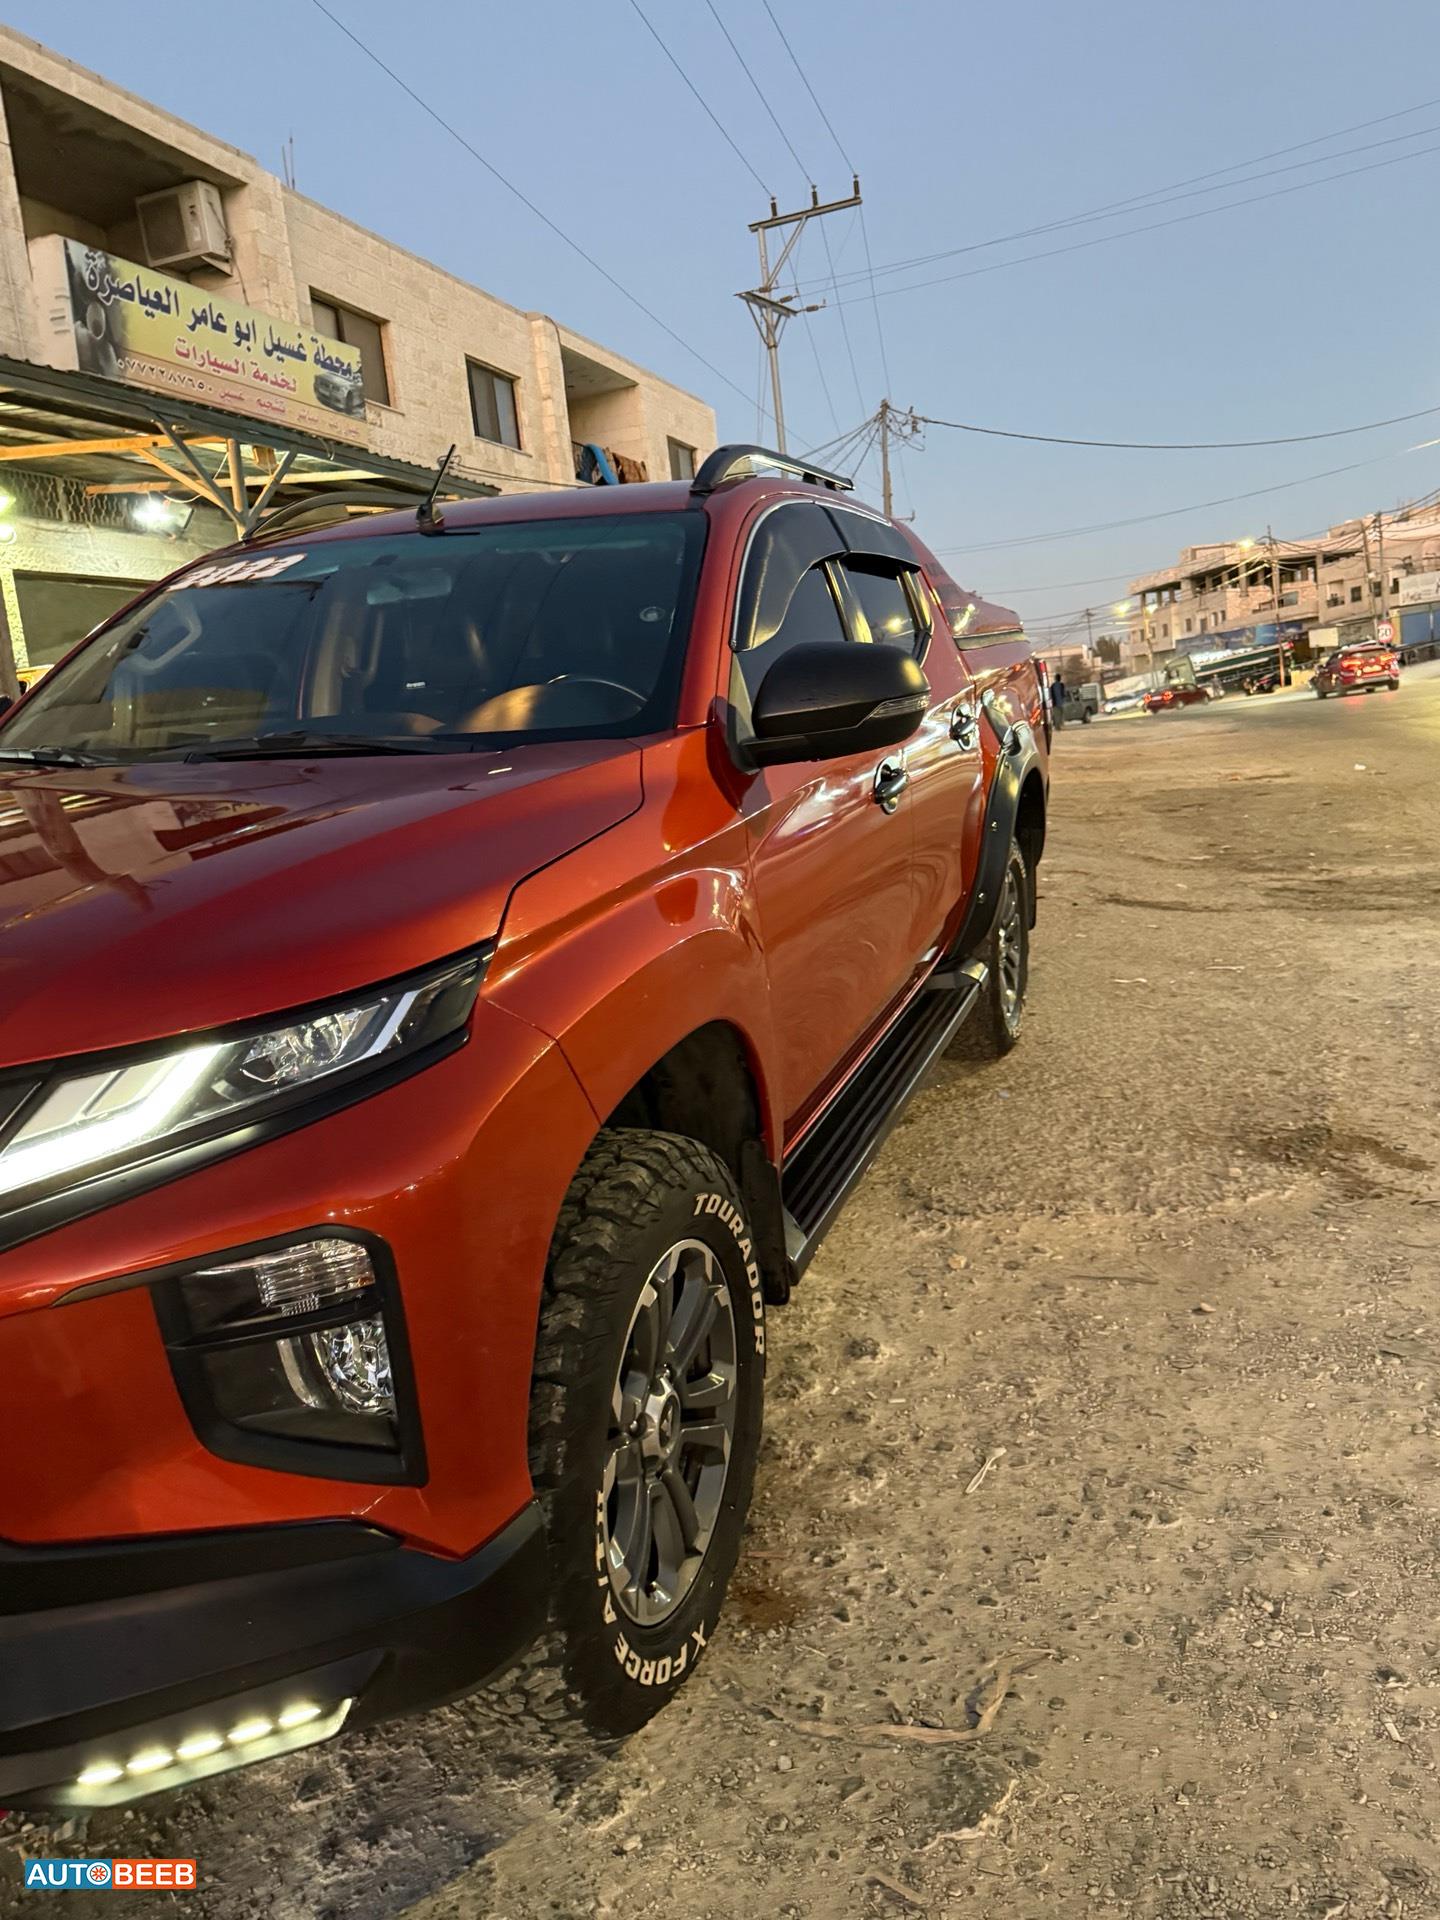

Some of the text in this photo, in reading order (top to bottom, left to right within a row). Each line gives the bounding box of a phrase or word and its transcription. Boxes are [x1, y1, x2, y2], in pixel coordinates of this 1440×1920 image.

[85, 251, 180, 319] العياصرة
[186, 301, 228, 332] عامر
[233, 318, 257, 348] ابو
[174, 336, 246, 377] السيارات
[263, 323, 307, 363] غسيل
[166, 552, 307, 592] 2022
[693, 1192, 765, 1355] TOURADOR
[614, 1631, 688, 1686] FORCE
[690, 1619, 707, 1662] X
